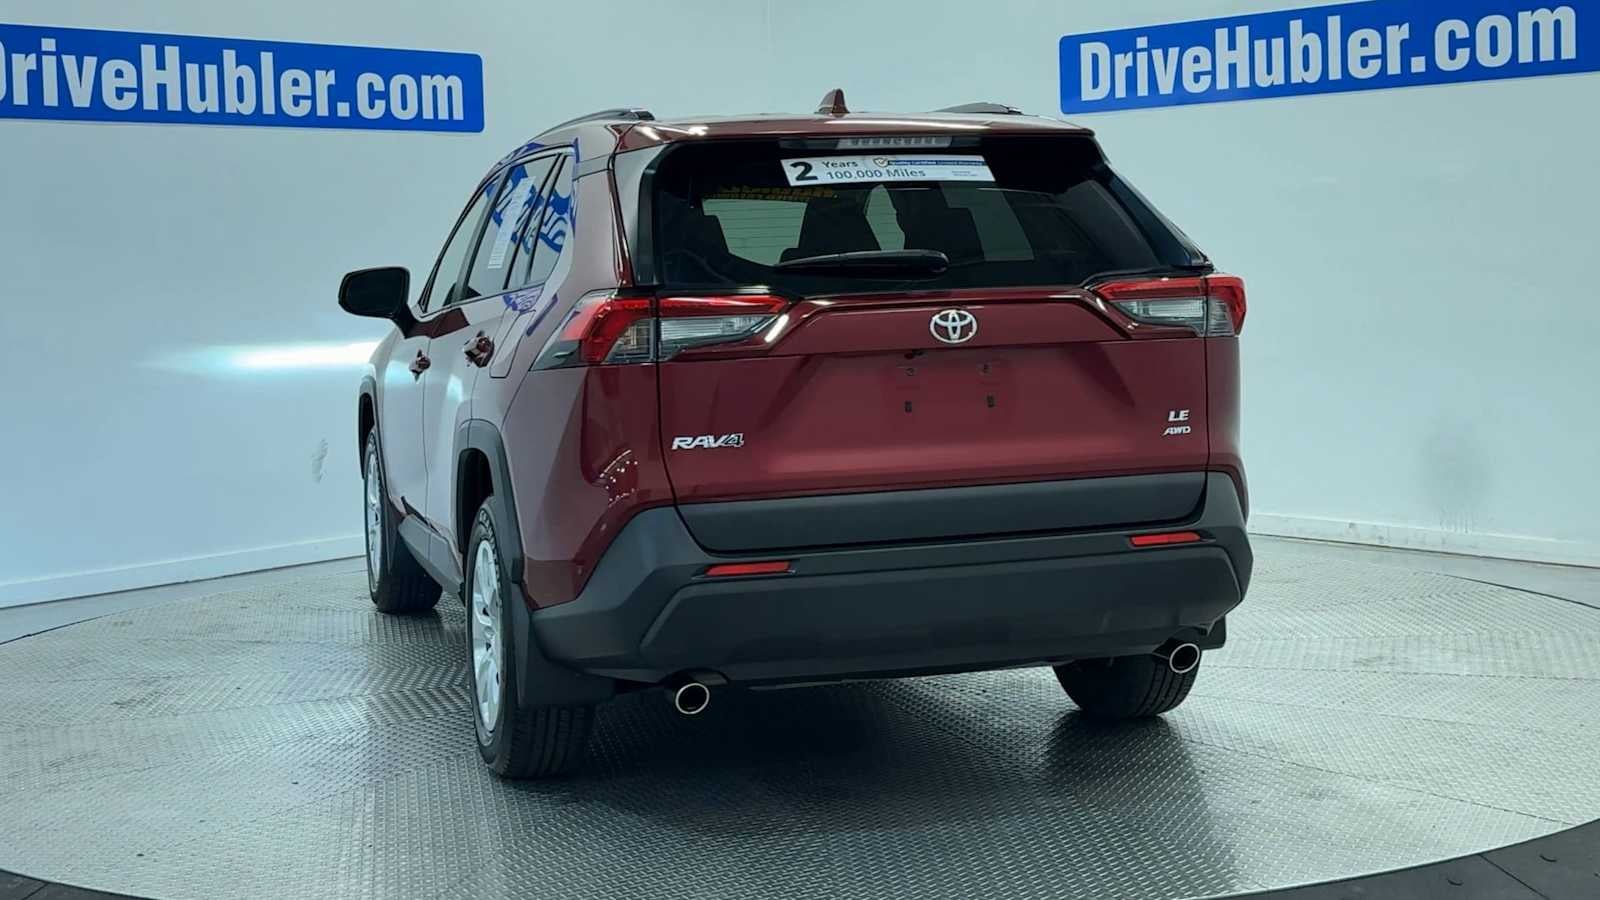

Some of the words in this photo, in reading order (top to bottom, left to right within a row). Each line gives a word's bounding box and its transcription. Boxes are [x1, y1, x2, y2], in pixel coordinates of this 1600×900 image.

[1079, 5, 1577, 101] DriveHubler.com
[0, 38, 464, 121] riveHubler.com
[790, 161, 819, 182] 2
[822, 159, 858, 169] Years
[886, 168, 926, 178] Miles
[1168, 409, 1190, 421] LE
[1161, 425, 1191, 436] AWD
[671, 432, 745, 450] RAV4
